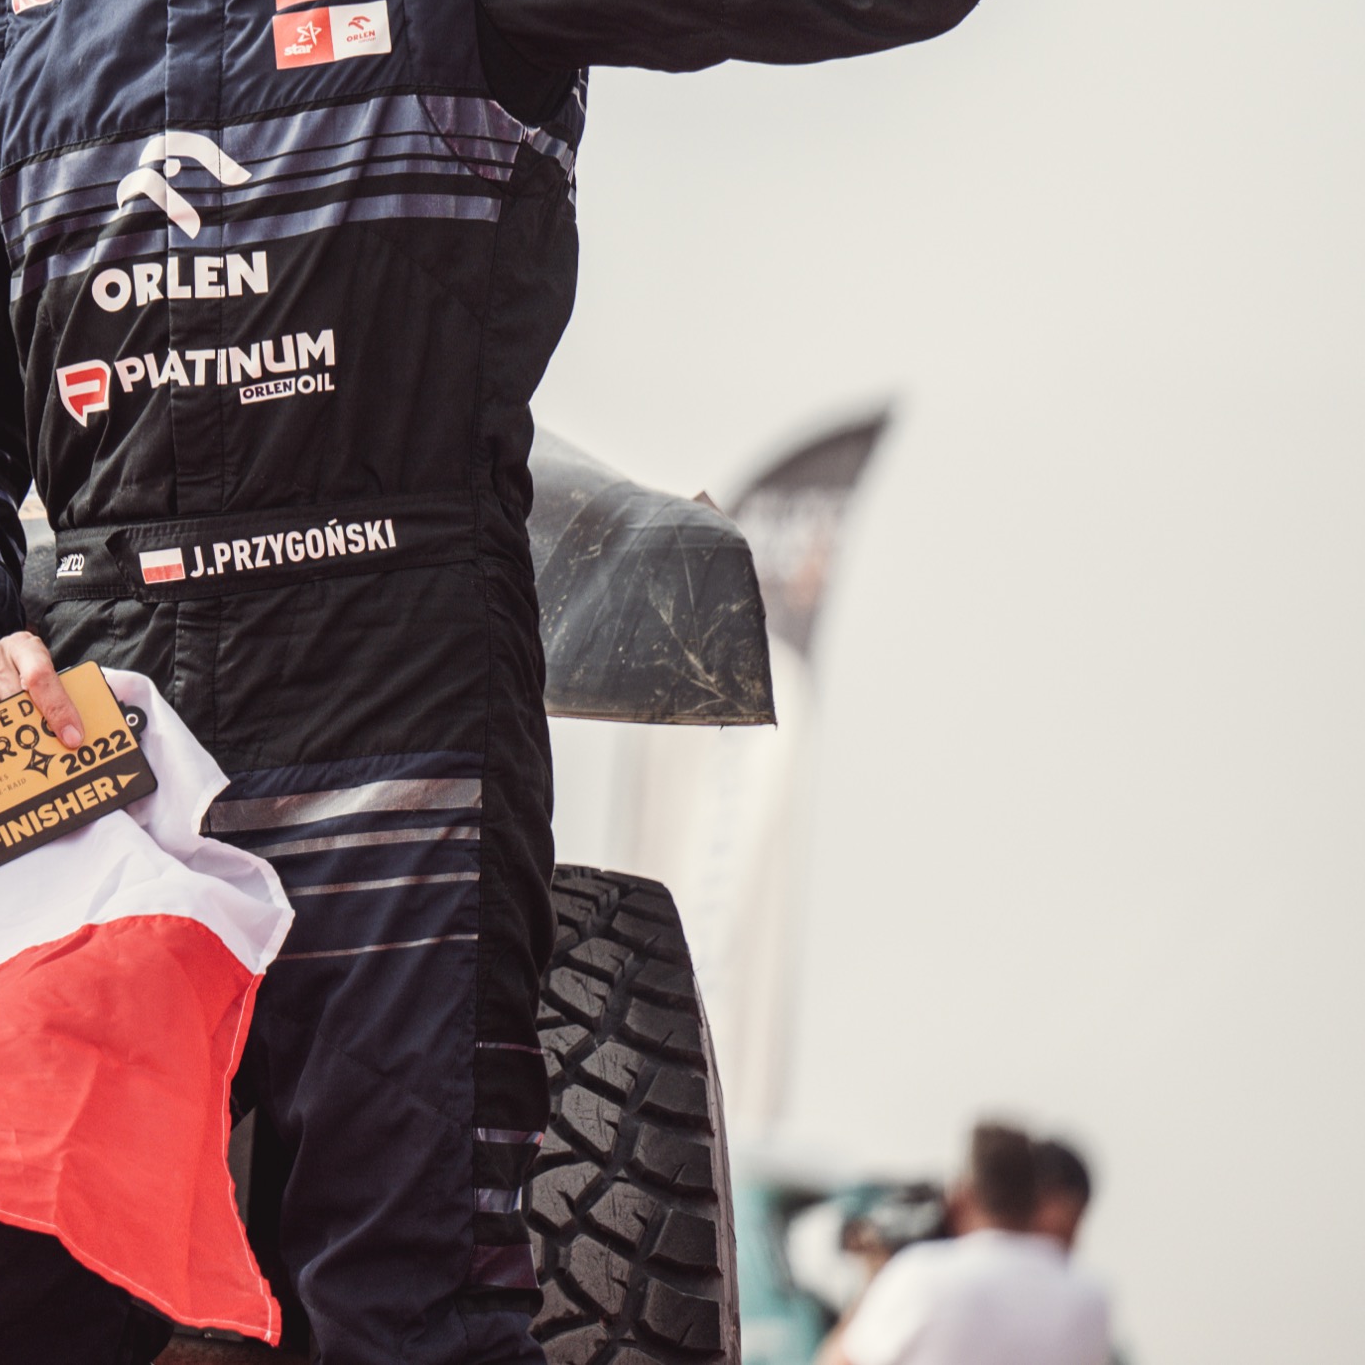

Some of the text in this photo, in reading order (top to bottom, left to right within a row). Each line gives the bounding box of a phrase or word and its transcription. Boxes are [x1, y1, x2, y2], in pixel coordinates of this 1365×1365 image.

[284, 43, 313, 57] star
[346, 29, 376, 43] ORLEN
[91, 250, 269, 312] ORLEN
[114, 329, 336, 393] PLATINUM
[242, 373, 335, 401] ORLEN OIL
[189, 518, 397, 578] J.PRZYGOŃSKI
[17, 699, 34, 717] D
[59, 729, 133, 777] 2022
